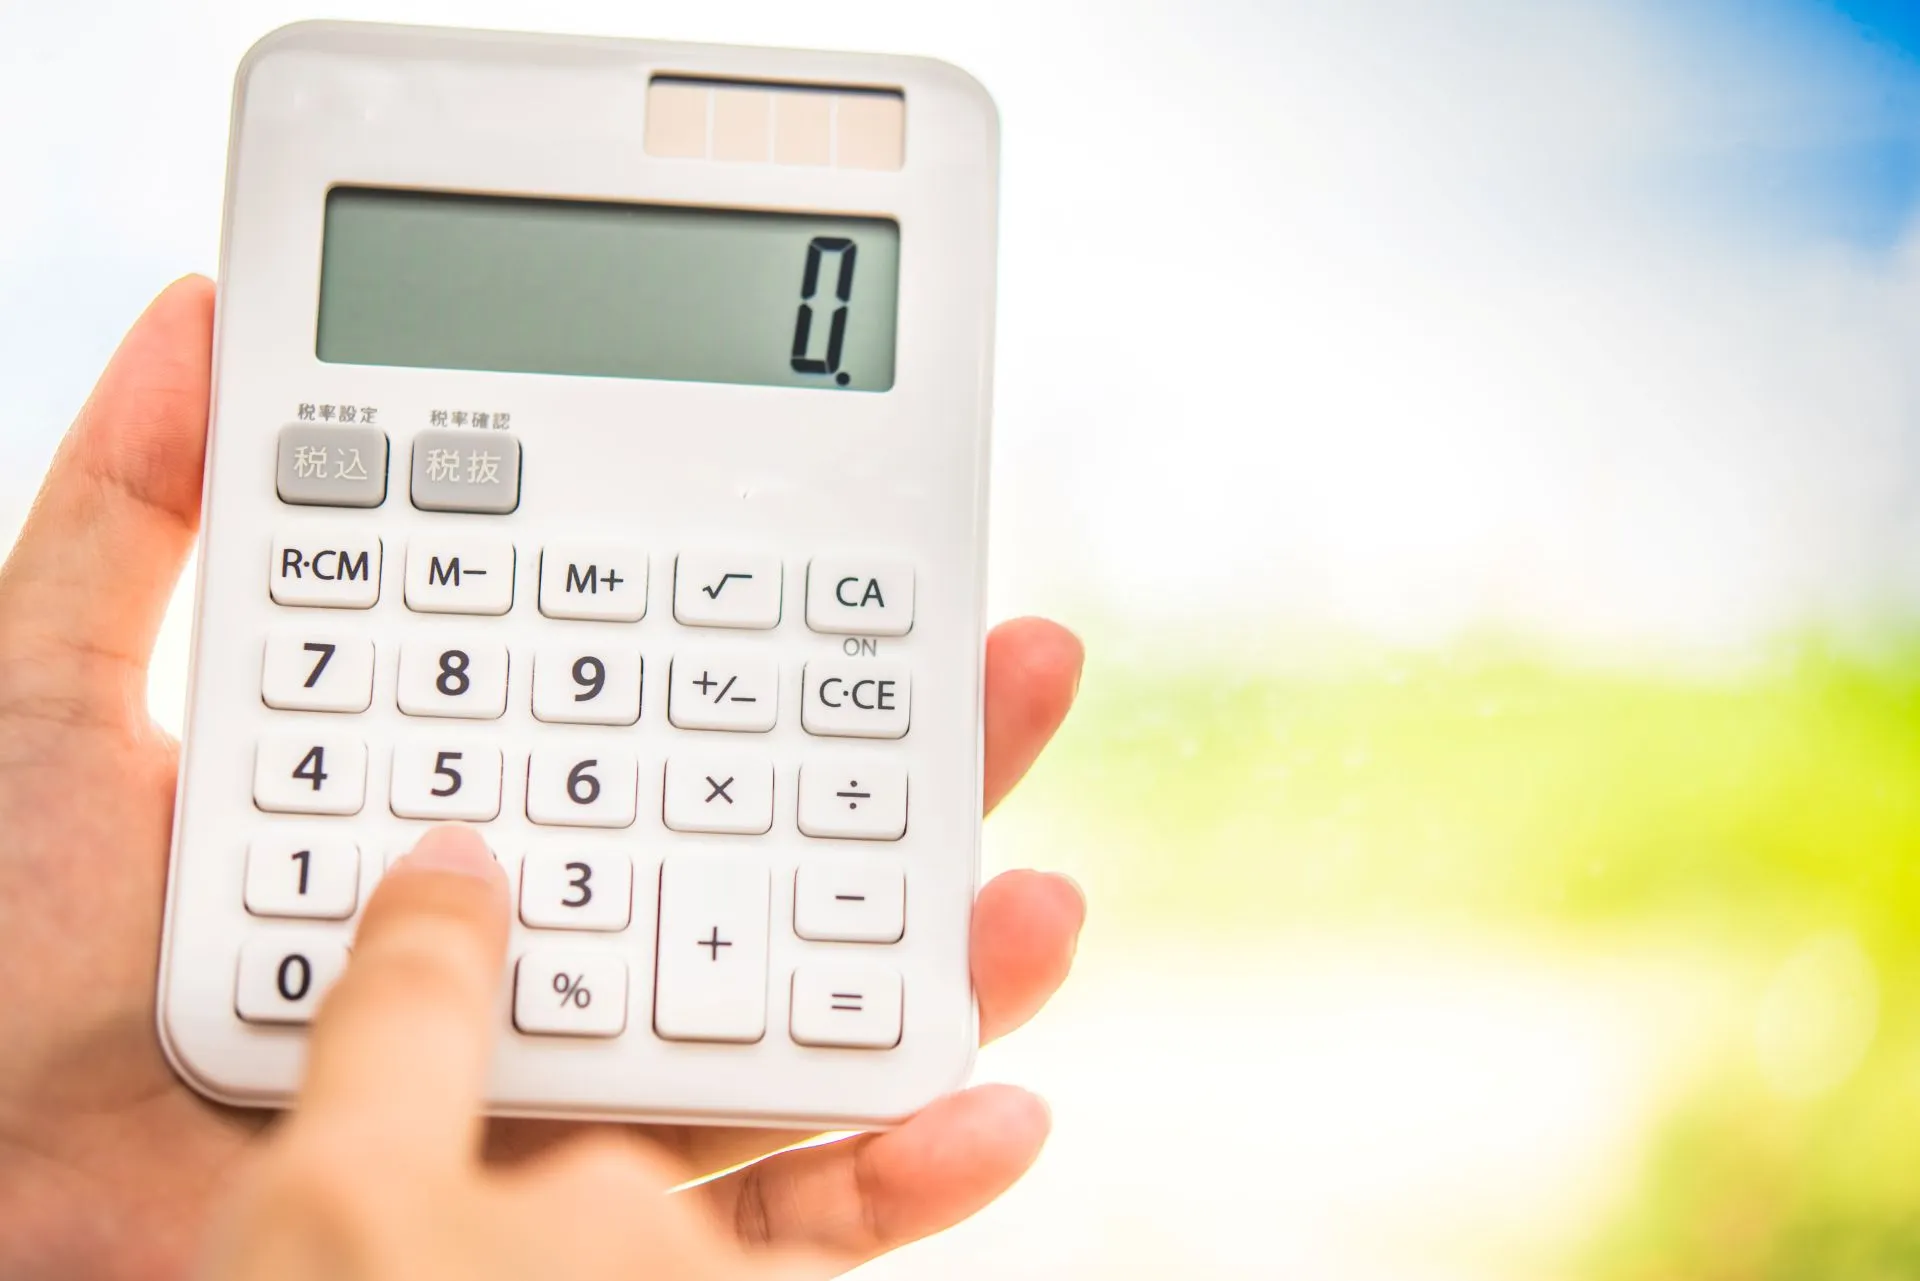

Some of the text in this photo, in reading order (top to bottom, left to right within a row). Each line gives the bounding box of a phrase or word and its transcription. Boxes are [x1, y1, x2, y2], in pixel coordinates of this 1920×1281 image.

[297, 403, 378, 423] 税率設定
[430, 410, 510, 430] 税率確認
[293, 445, 368, 480] 税込
[425, 448, 502, 484] 税抜
[565, 563, 624, 595] M+
[835, 576, 885, 608] CA
[303, 642, 336, 688] 7
[843, 637, 878, 657] ON
[435, 649, 470, 697] 8
[571, 655, 606, 702] 9
[291, 745, 328, 792] 4
[430, 751, 463, 798] 5
[566, 759, 601, 805] 6
[291, 850, 311, 895] 1
[561, 861, 593, 908] 3
[276, 953, 312, 1002] 0
[552, 972, 591, 1009] %
